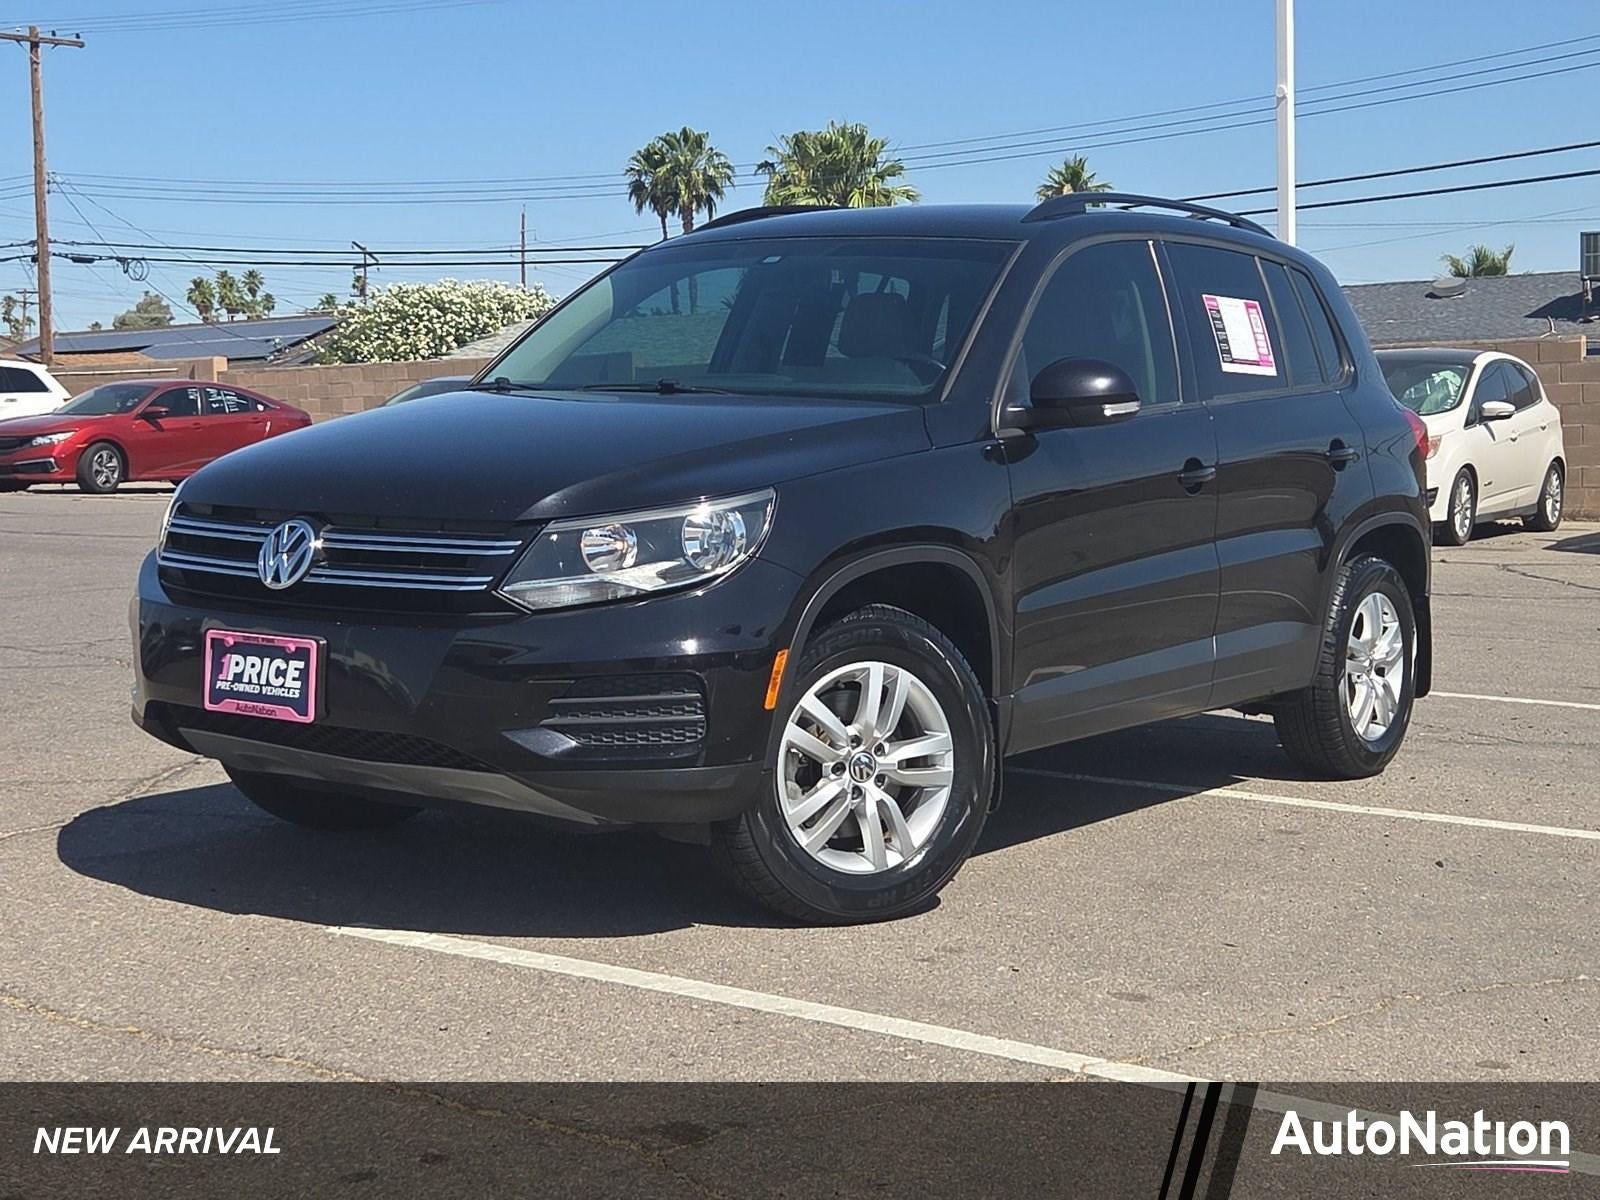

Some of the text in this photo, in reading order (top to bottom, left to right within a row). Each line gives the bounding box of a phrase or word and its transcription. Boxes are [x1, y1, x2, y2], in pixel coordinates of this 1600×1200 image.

[215, 680, 301, 698] PRE-OWNED VEHICLES
[234, 702, 278, 717] AutoNation
